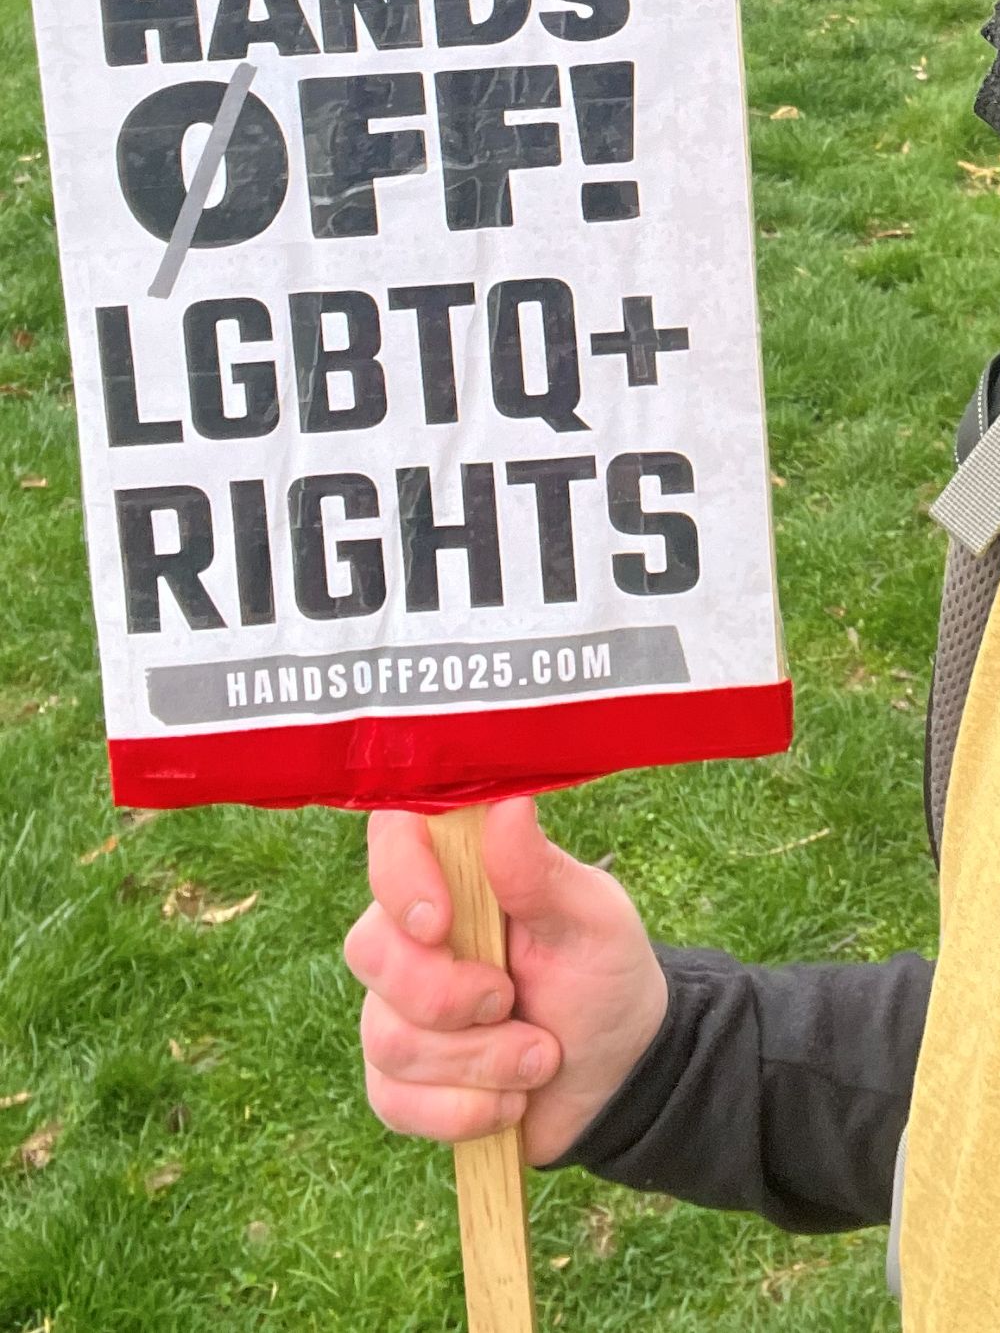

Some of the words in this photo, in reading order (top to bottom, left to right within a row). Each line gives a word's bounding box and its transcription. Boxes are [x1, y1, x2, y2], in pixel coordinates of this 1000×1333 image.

[116, 61, 640, 249] OFF!
[95, 277, 690, 448] LGBTQ+
[114, 451, 701, 634] RIGHTS
[226, 642, 612, 707] HANDSOFF2025.COM
